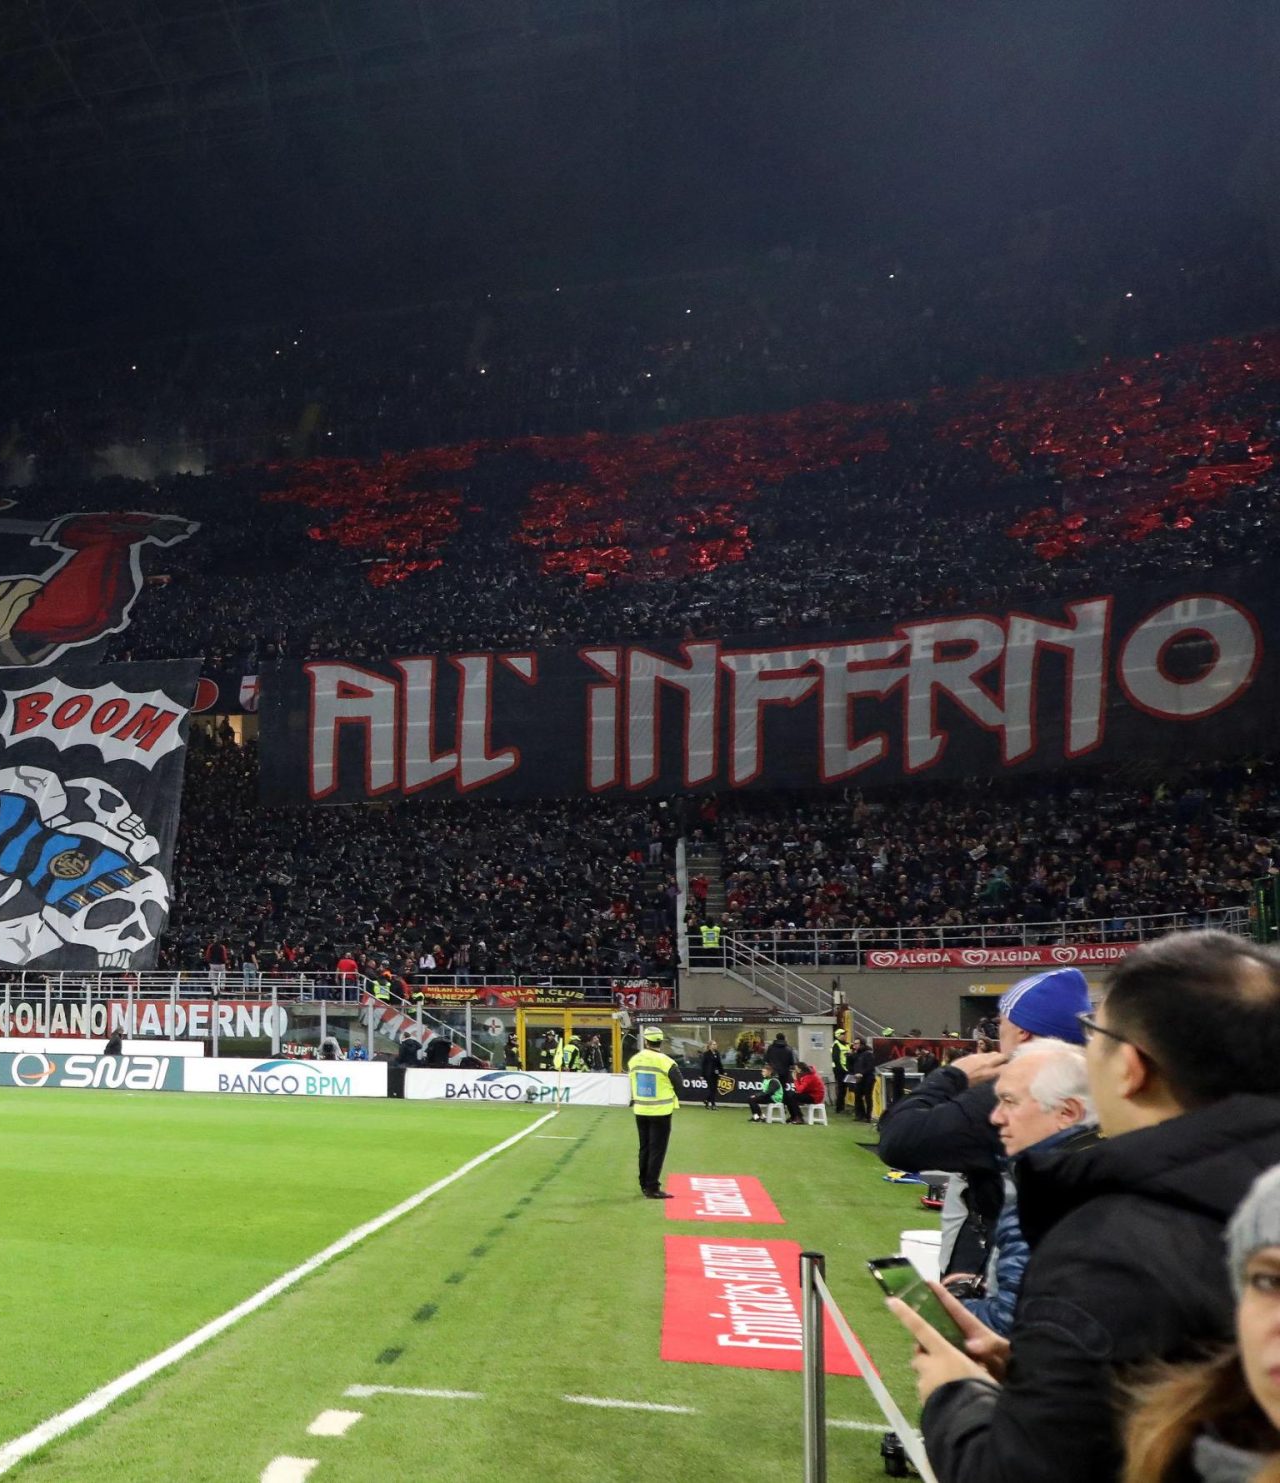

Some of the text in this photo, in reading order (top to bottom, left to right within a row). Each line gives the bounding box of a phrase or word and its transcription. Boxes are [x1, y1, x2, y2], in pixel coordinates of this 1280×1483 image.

[10, 691, 179, 752] BOOM
[899, 953, 950, 964] ALGIDA
[991, 951, 1041, 962] ALGIDA
[1080, 948, 1127, 960] ALGIDA
[502, 989, 586, 999] MILAN CLUB
[111, 1002, 289, 1038] MADERNO
[219, 1074, 351, 1096] BANCO BPM
[691, 1079, 708, 1089] 105
[718, 1080, 733, 1090] 105
[445, 1082, 521, 1100] BANCO
[709, 1282, 803, 1351] Emirates
